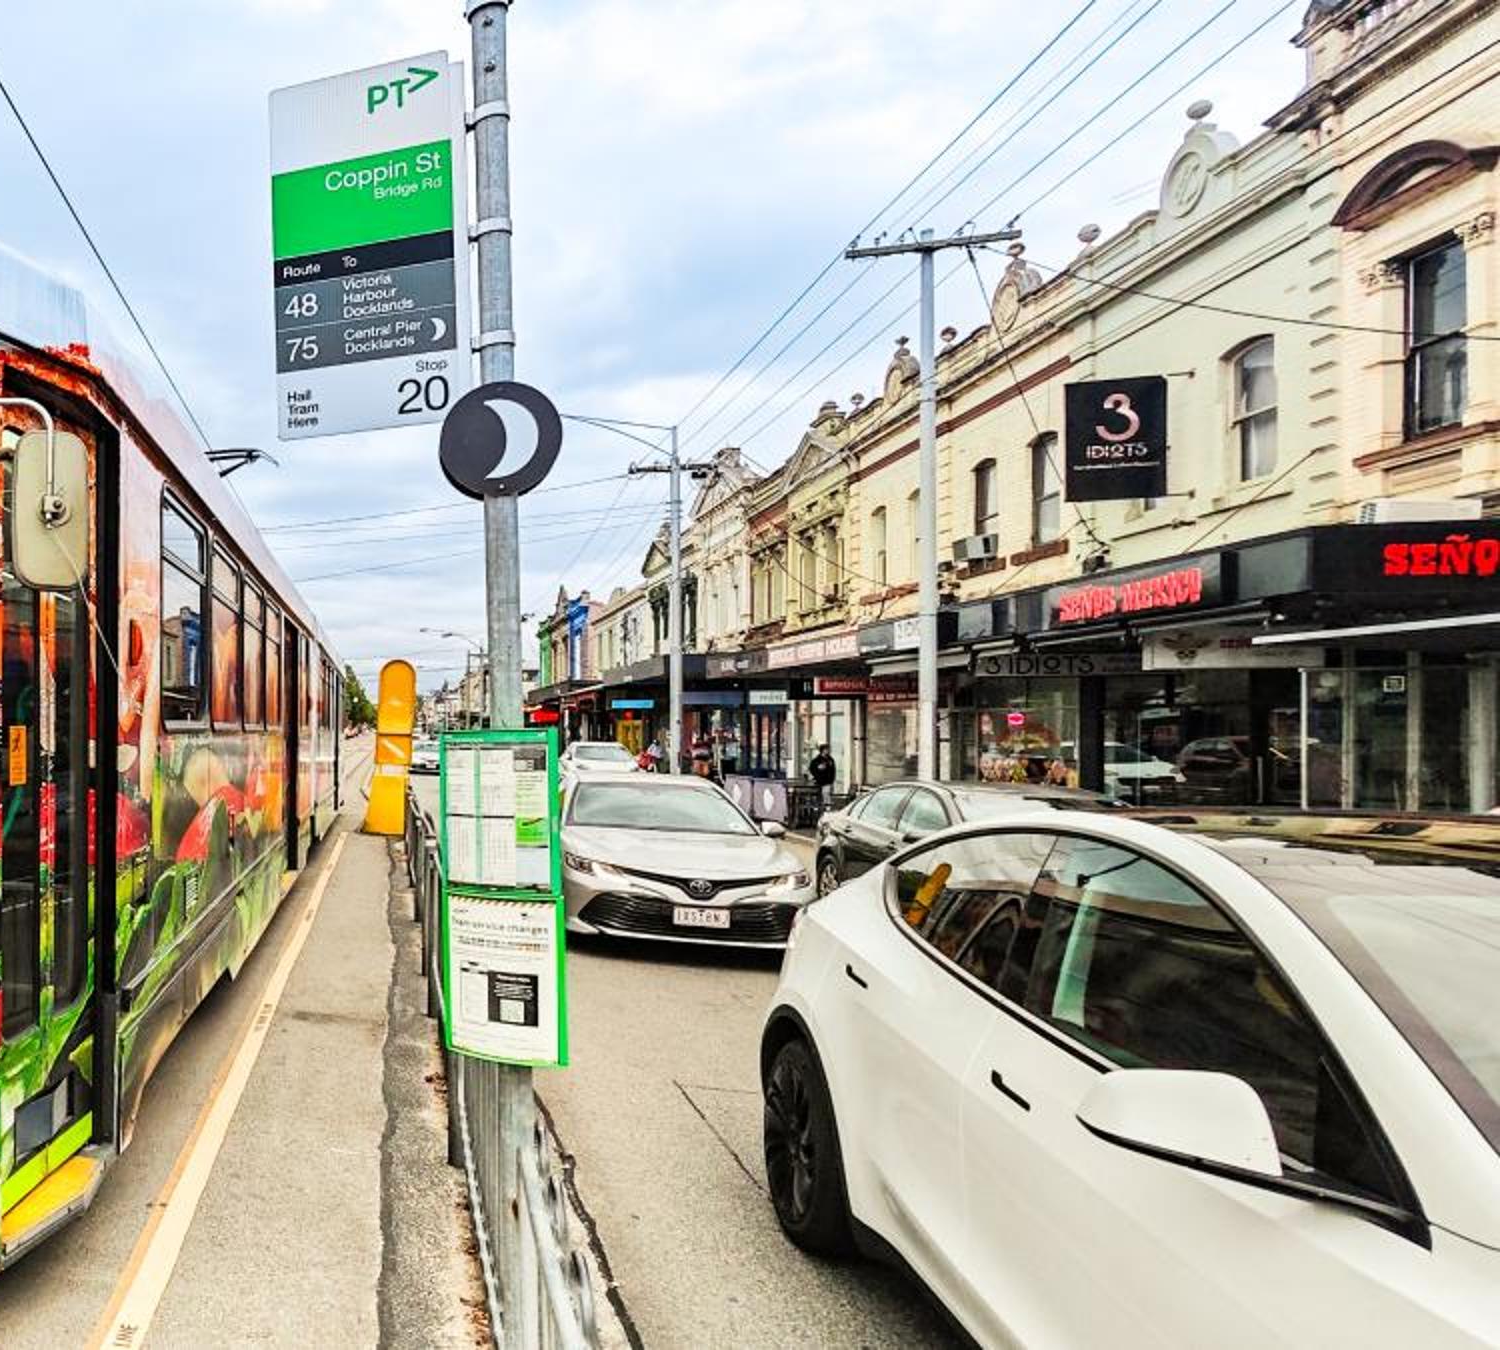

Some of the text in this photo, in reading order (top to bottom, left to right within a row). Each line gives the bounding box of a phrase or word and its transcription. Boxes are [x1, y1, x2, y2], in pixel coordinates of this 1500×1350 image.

[325, 152, 441, 191] Coppin St
[374, 176, 443, 199] Bridge Rd
[283, 255, 357, 279] Route To
[342, 273, 392, 290] Victoria
[285, 287, 397, 319] 48 Harbour
[343, 297, 415, 318] Docklands
[286, 319, 423, 363] 75 Central Pier
[345, 335, 415, 355] Docklands
[415, 358, 449, 373] Stop
[288, 389, 312, 403] Hail
[398, 375, 450, 415] 20
[288, 403, 319, 415] Tram
[1095, 392, 1141, 442] 3
[288, 416, 319, 429] Here
[1085, 442, 1148, 459] IDIOTS
[984, 655, 1001, 675] 3
